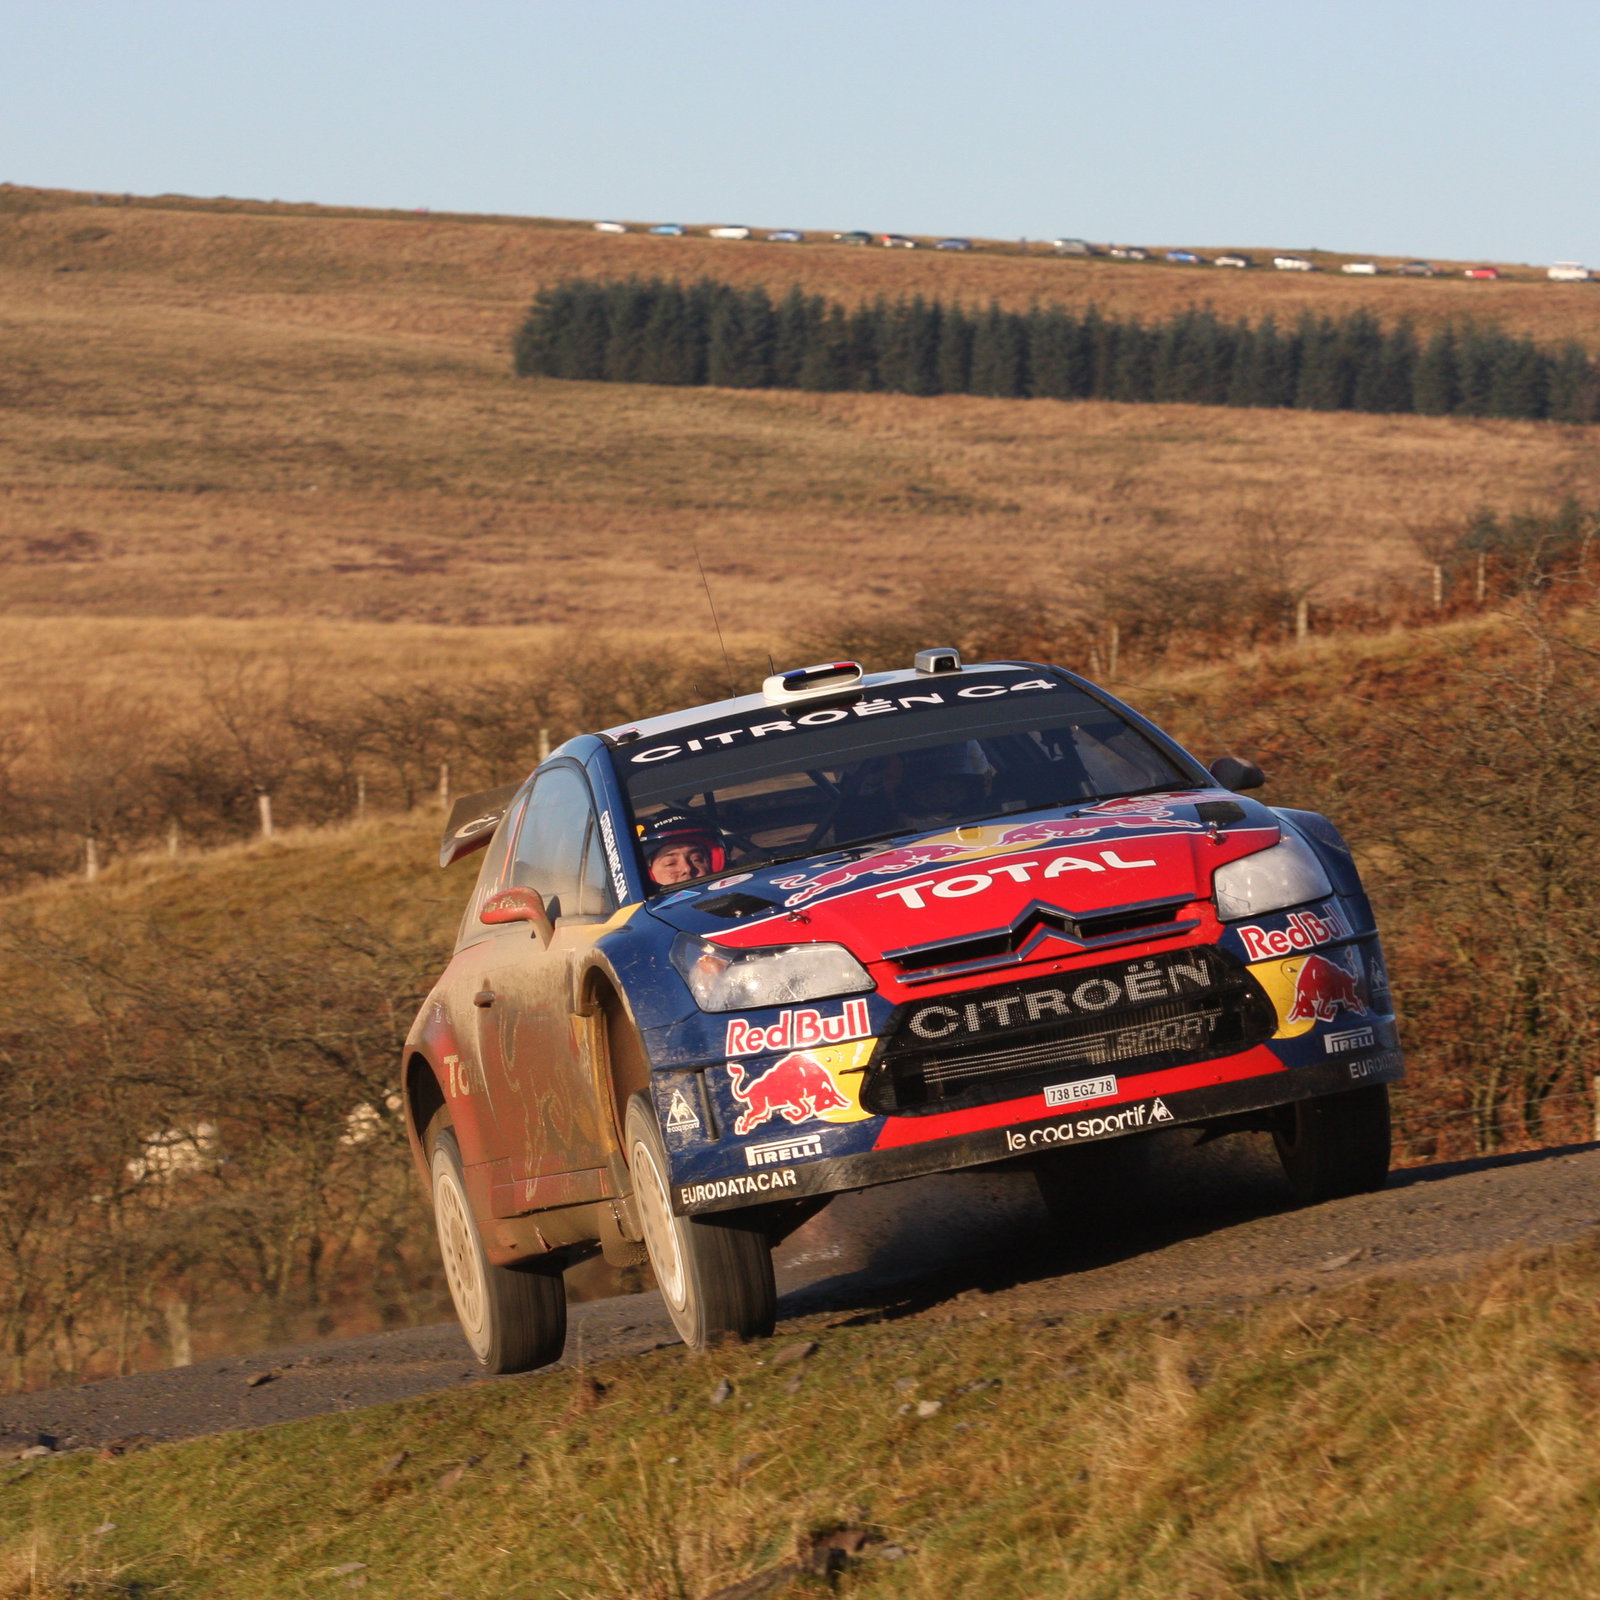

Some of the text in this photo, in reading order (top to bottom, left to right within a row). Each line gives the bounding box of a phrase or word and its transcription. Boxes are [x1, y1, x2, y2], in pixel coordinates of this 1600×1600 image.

[631, 678, 1057, 763] CITROËN C4
[876, 851, 1156, 909] TOTAL
[1237, 903, 1354, 961] Red Bull
[909, 959, 1212, 1039] CITROËN
[725, 998, 872, 1057] Red Bull
[1117, 1012, 1222, 1051] SPORT
[1324, 1026, 1375, 1053] PIRELLI
[1050, 1080, 1112, 1101] 738 EGZ 78
[744, 1134, 823, 1167] PIRELLI
[1006, 1130, 1027, 1151] le
[1077, 1104, 1146, 1137] sportif
[681, 1169, 797, 1205] EURODATACAR
